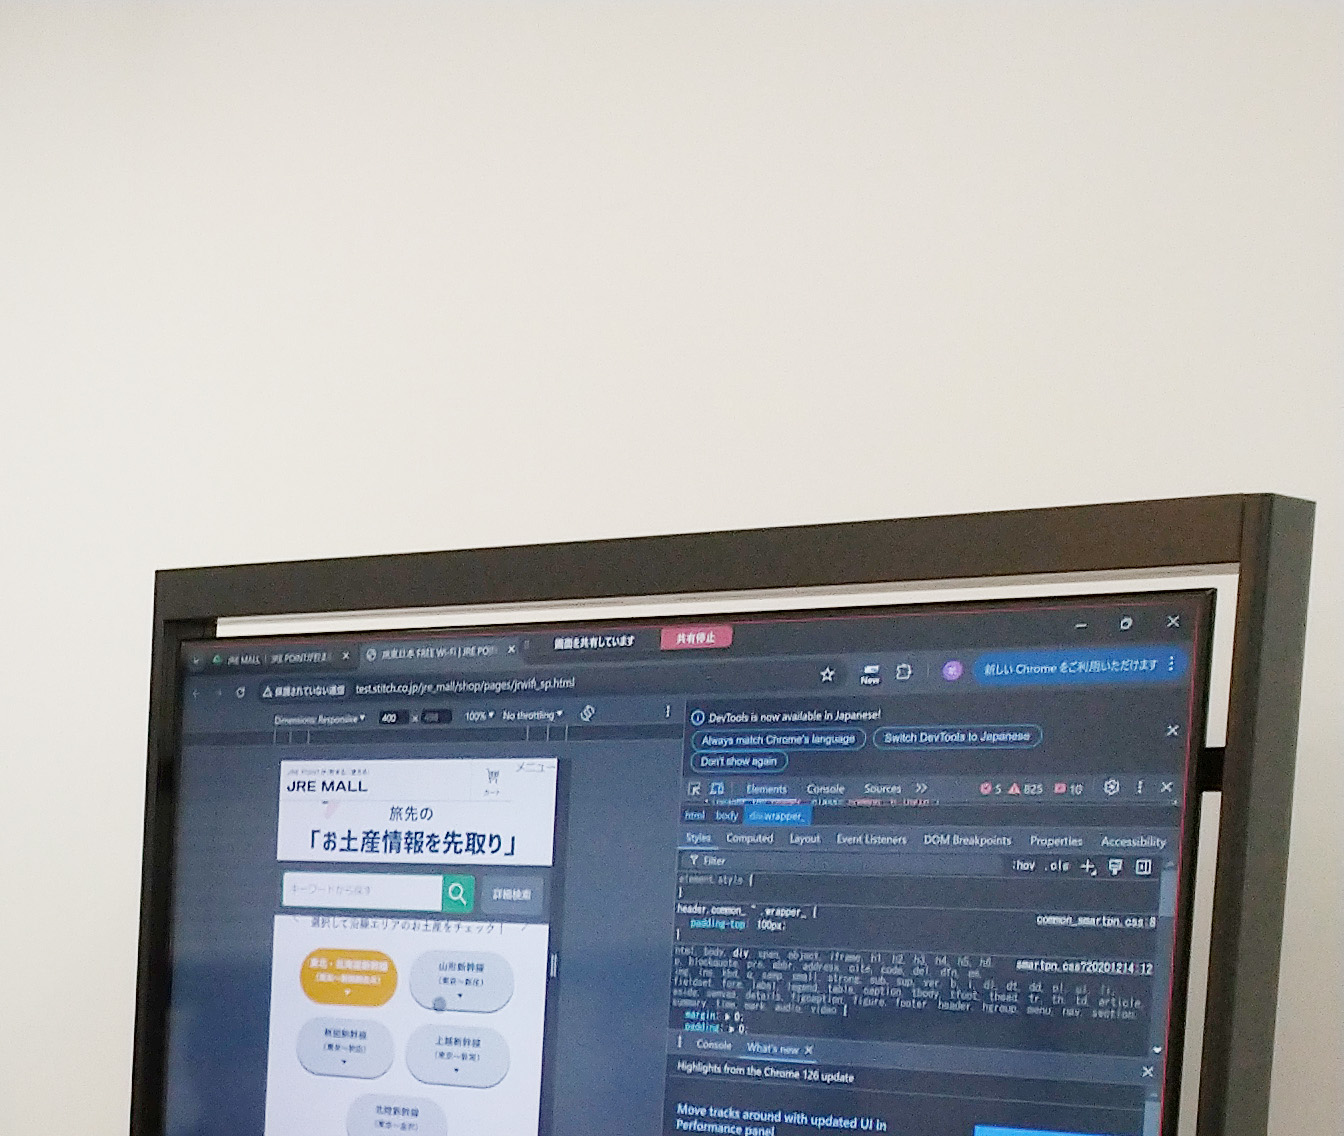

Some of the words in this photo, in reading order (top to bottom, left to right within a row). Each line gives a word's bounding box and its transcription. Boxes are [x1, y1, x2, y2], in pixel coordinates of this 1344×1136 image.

[676, 631, 715, 645] 共有停止
[984, 662, 1012, 676] 新しい
[1015, 663, 1057, 675] Chrome
[861, 676, 881, 686] New
[465, 711, 486, 721] 100%
[502, 710, 515, 721] No
[518, 709, 555, 722] throttling
[709, 711, 749, 723] DevTools
[750, 711, 758, 722] is
[760, 712, 780, 722] now
[782, 710, 822, 722] available
[824, 710, 832, 720] in
[702, 735, 733, 747] Always
[735, 734, 763, 745] match
[765, 734, 809, 745] Chrome's
[812, 733, 856, 746] language
[885, 731, 917, 743] Switch
[920, 731, 966, 743] DevTools
[968, 731, 977, 742] to
[980, 731, 1030, 743] Japanese
[700, 756, 724, 767] Don't
[726, 756, 750, 767] show
[752, 757, 777, 768] again
[286, 780, 316, 792] JRE
[321, 780, 368, 792] MALL
[746, 784, 788, 795] Elements
[807, 784, 845, 795] Console
[864, 784, 901, 795] Sources
[389, 806, 434, 821] 旅先の
[685, 810, 706, 821] html
[715, 810, 739, 822] body
[310, 829, 516, 857] 「お土産情報を先取り」
[686, 832, 711, 843] Styles
[726, 832, 774, 844] Computed
[790, 833, 821, 845] Layout
[837, 834, 862, 844] Event
[865, 834, 907, 845] Listeners
[924, 834, 950, 845] DOM
[953, 834, 1012, 846] Breakpoints
[1030, 835, 1083, 847] Properties
[1101, 836, 1167, 849] Accessibility
[703, 856, 726, 866] Filter
[696, 1039, 732, 1050] Console
[746, 1041, 778, 1053] What's
[780, 1045, 801, 1055] new
[677, 1060, 722, 1075] Highlights
[724, 1064, 745, 1076] from
[746, 1065, 762, 1077] the
[764, 1067, 799, 1080] Chrome
[803, 1069, 819, 1081] 126
[821, 1071, 855, 1085] update
[677, 1102, 706, 1116] Move
[709, 1105, 740, 1119] tracks
[742, 1109, 782, 1123] around
[785, 1111, 808, 1125] with
[811, 1114, 857, 1129] updated
[860, 1116, 874, 1130] UI
[876, 1118, 887, 1132] in
[676, 1118, 743, 1136] Performance
